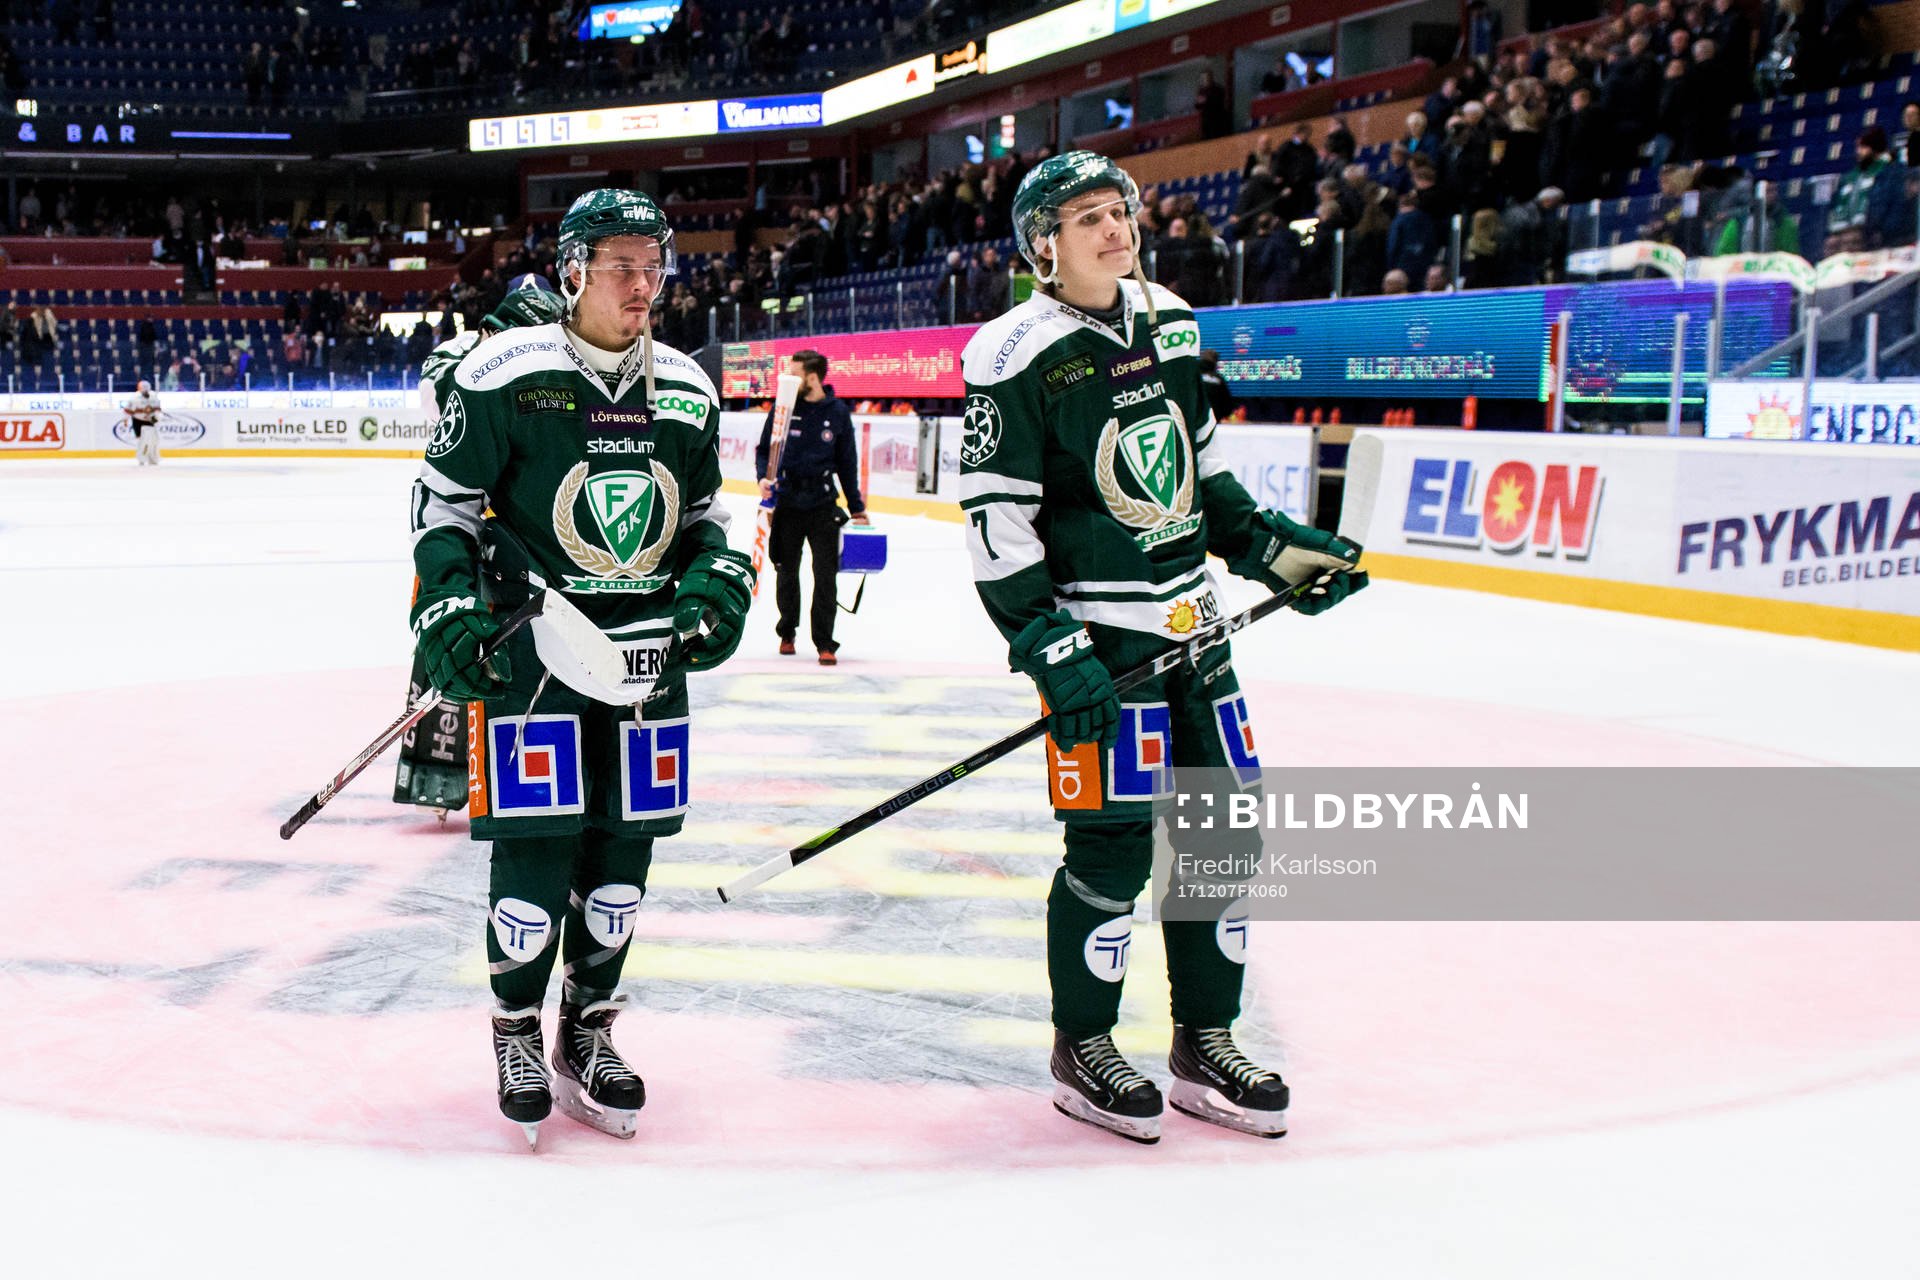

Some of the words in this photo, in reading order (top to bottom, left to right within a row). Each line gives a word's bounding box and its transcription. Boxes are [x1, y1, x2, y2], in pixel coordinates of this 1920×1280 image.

[18, 122, 37, 141] &
[66, 123, 136, 143] BAR
[1057, 304, 1103, 331] stadium
[471, 341, 558, 384] MOELVEN
[562, 343, 595, 379] stadium
[1110, 355, 1154, 378] LÖFBERGS
[518, 388, 576, 403] GRÖNSAKS
[536, 400, 568, 411] HUSET
[1112, 380, 1166, 410] stadium
[591, 410, 648, 425] LÖFBERGS
[656, 397, 707, 421] coop
[237, 418, 306, 435] Lumine
[313, 420, 347, 434] LED
[586, 437, 656, 454] stadium
[1402, 458, 1603, 555] ELON
[970, 508, 1001, 562] 7
[1144, 521, 1194, 544] KARLSTAD
[589, 580, 653, 590] KARLSTAD
[1152, 607, 1252, 676] CCM
[1075, 1069, 1101, 1091] CCM
